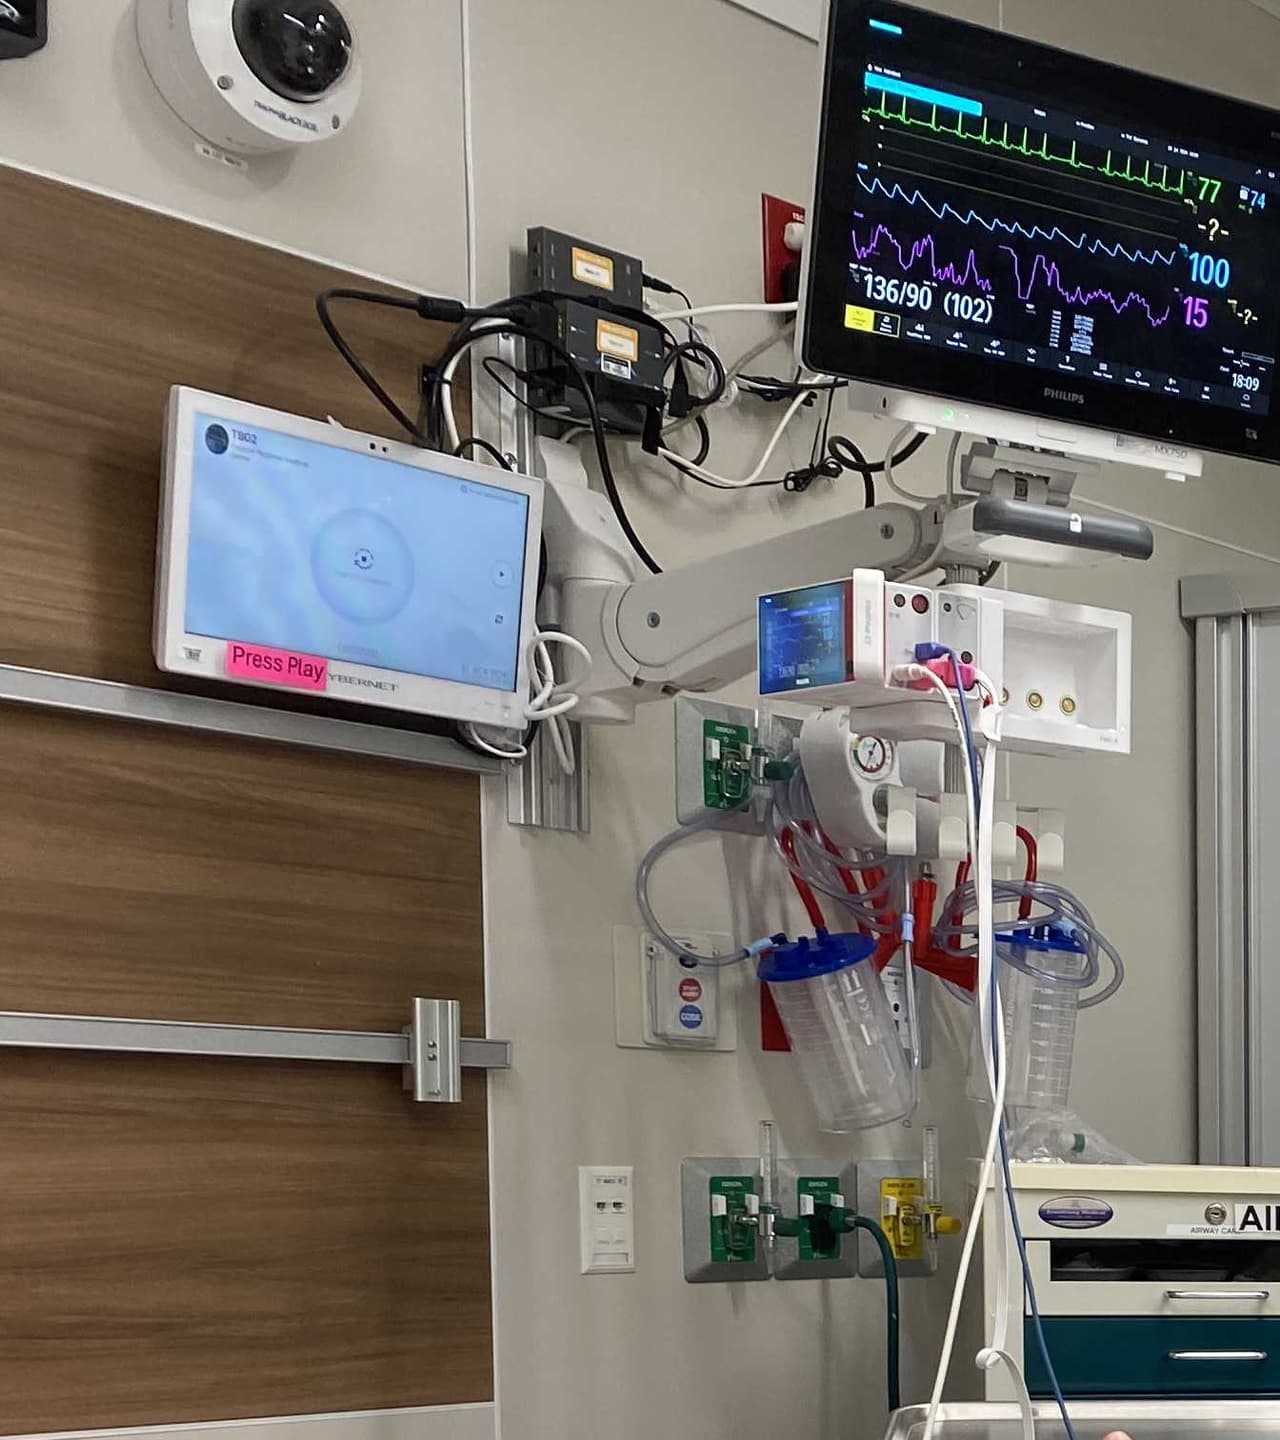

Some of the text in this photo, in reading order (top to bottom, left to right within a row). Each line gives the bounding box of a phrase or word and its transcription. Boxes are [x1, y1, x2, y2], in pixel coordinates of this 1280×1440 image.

[1198, 176, 1221, 203] 77
[1250, 190, 1266, 209] 74
[1189, 251, 1230, 288] 100
[864, 273, 993, 324] 136/90 (102)
[1183, 296, 1209, 328] 15
[1232, 372, 1260, 391] 18:09
[1043, 387, 1085, 404] PHILIPS
[232, 646, 325, 684] Press Play
[327, 673, 398, 692] YBERNET
[1190, 1227, 1220, 1235] AIRWAY
